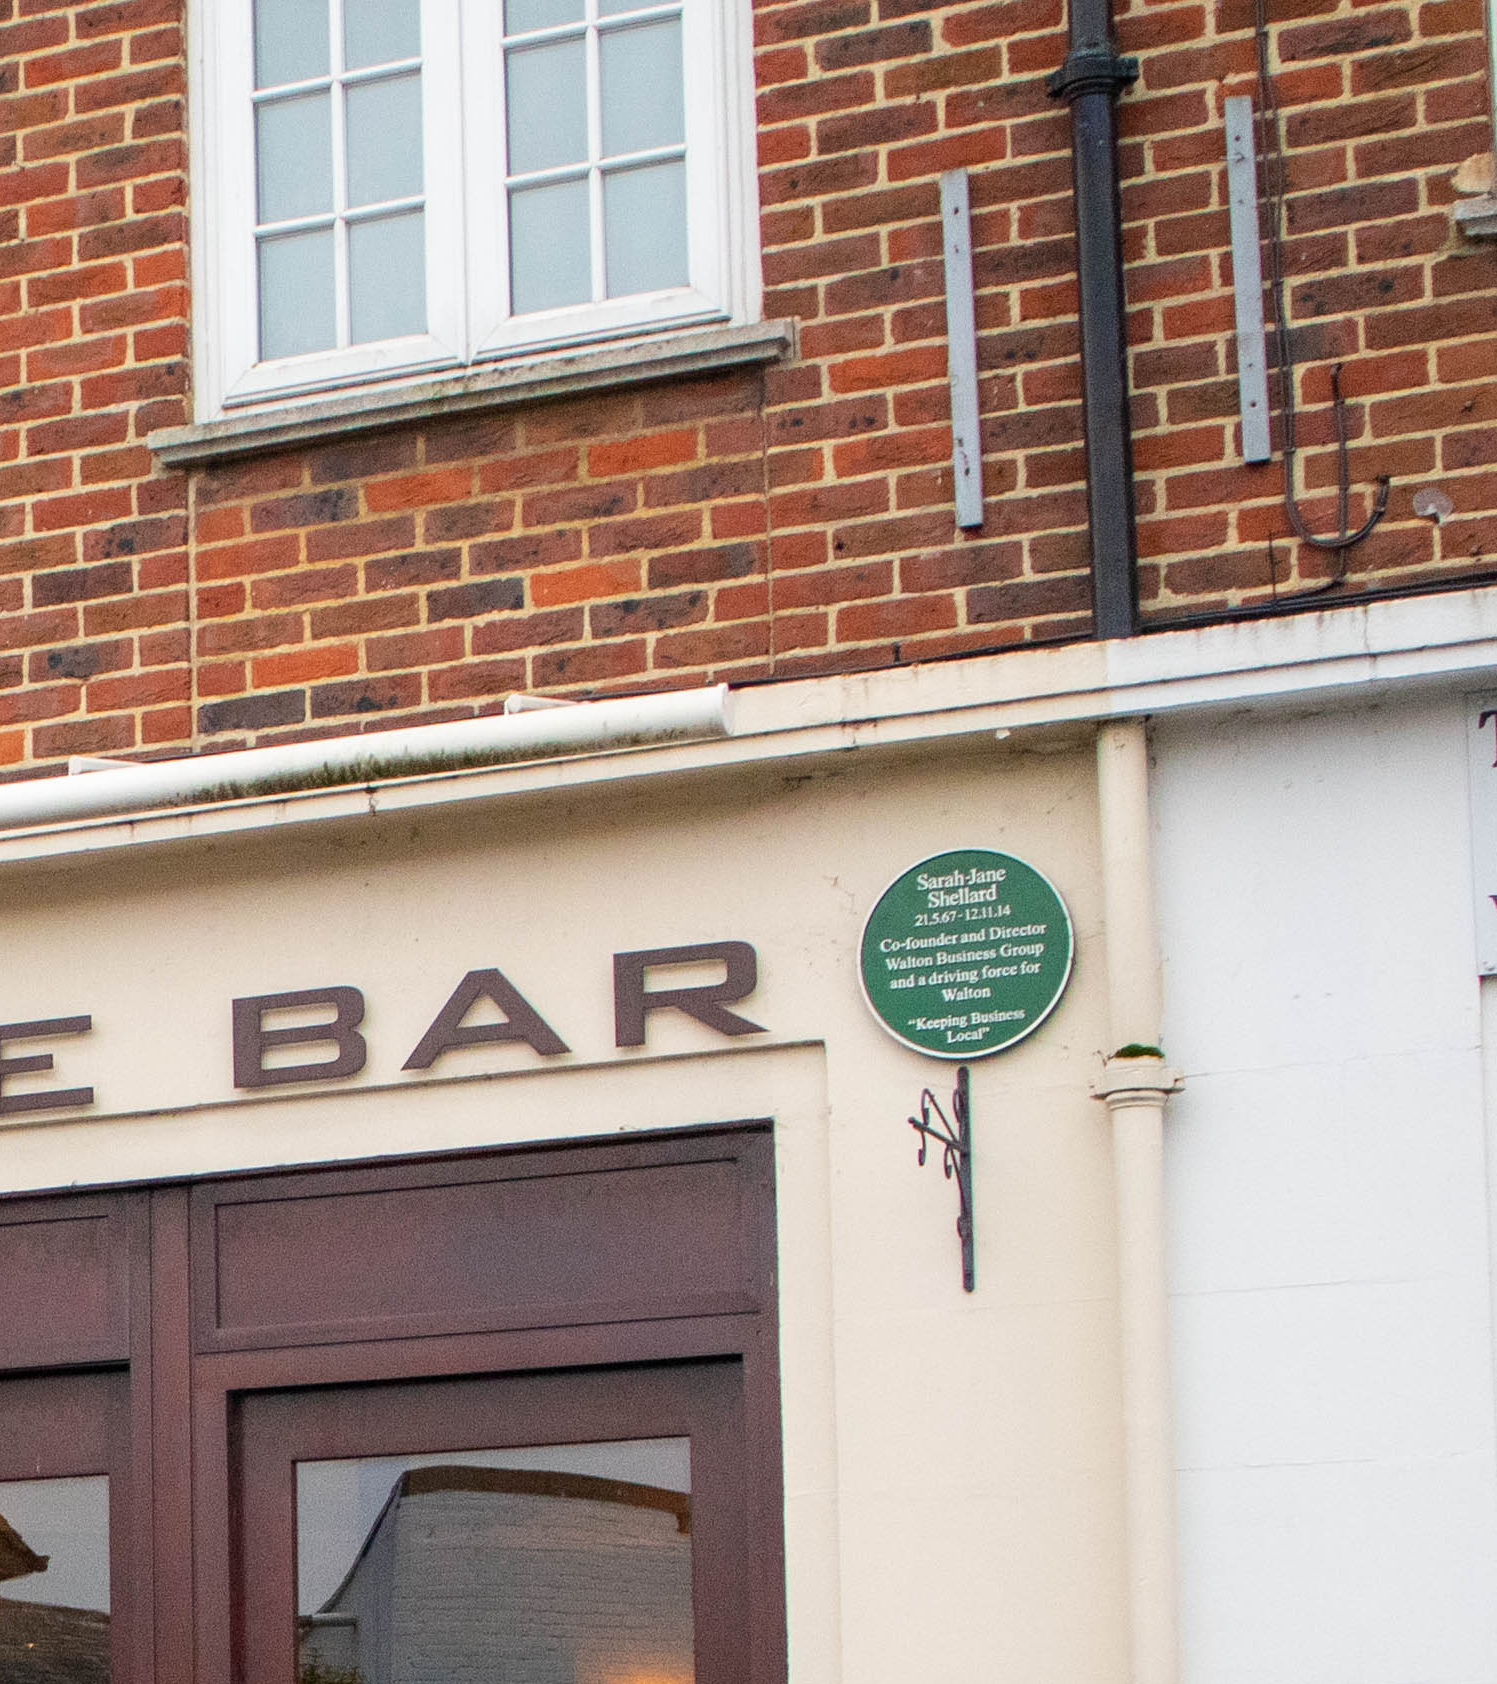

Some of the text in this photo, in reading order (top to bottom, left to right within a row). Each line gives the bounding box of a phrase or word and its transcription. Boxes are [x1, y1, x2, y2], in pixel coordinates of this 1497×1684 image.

[916, 867, 1006, 891] Sarah-Jane
[927, 884, 998, 909] Shellard
[880, 923, 1047, 953] Co-founder and Director
[885, 942, 1045, 971] Walton Business Group
[890, 960, 1042, 989] and a driving force for
[942, 985, 992, 1002] Walton
[231, 939, 769, 1090] BAR
[971, 1008, 1026, 1025] Business
